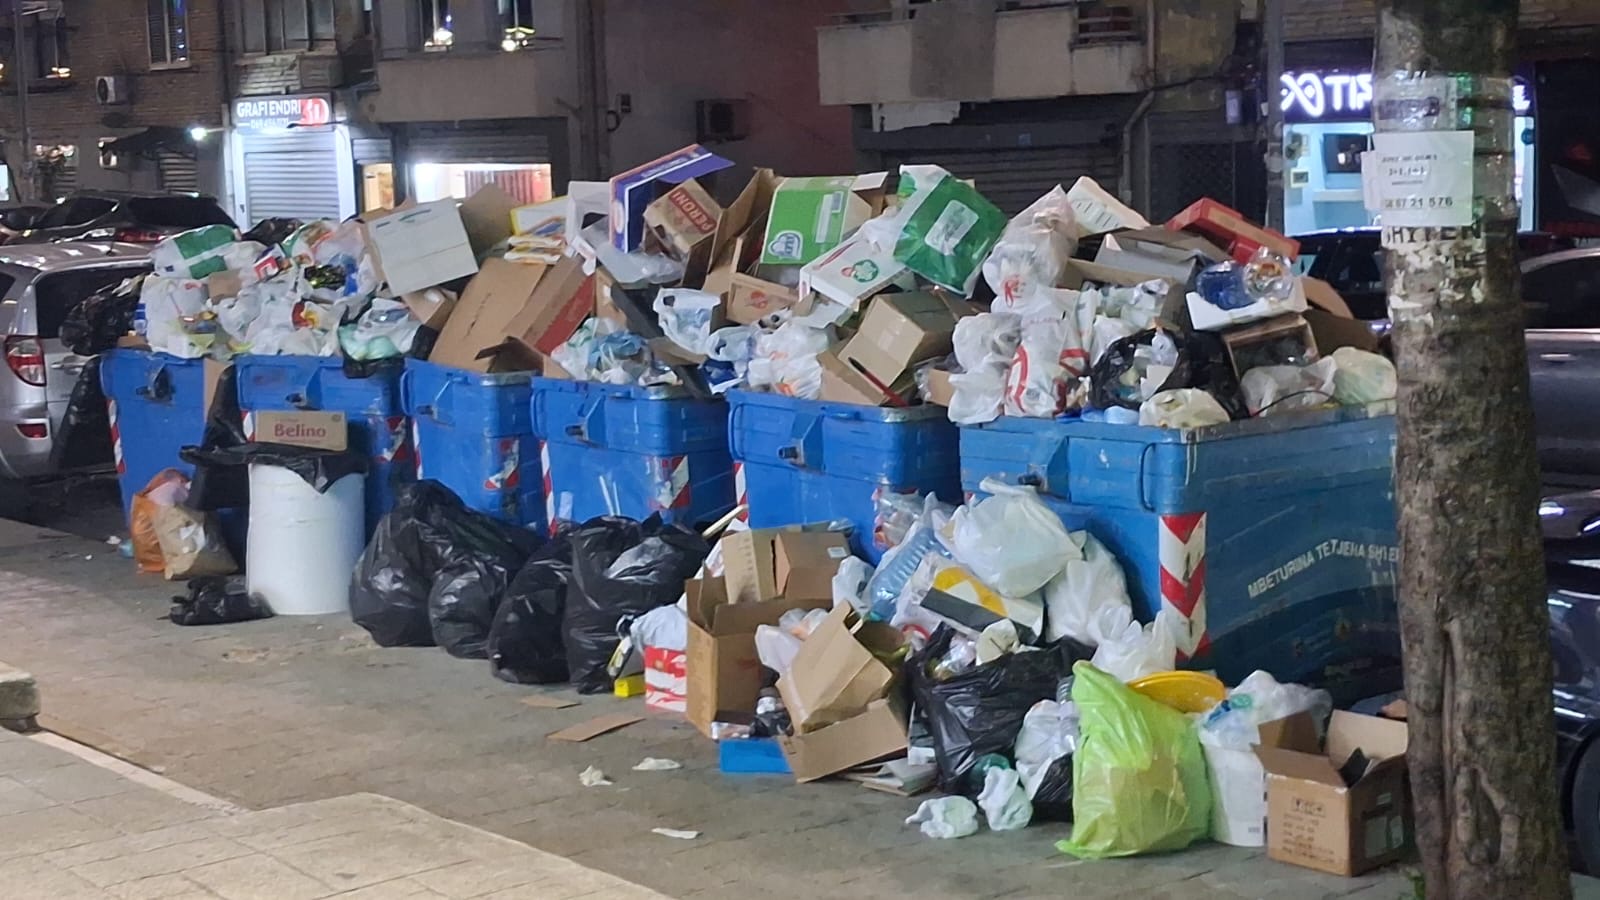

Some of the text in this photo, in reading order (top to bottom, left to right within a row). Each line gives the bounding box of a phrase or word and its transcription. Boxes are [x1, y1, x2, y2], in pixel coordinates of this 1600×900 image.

[237, 101, 267, 118] GRAFI
[268, 99, 301, 116] ENDRI
[671, 190, 715, 231] PERONI
[1410, 197, 1423, 209] 21
[1428, 196, 1454, 209] 576
[274, 423, 327, 438] Belino
